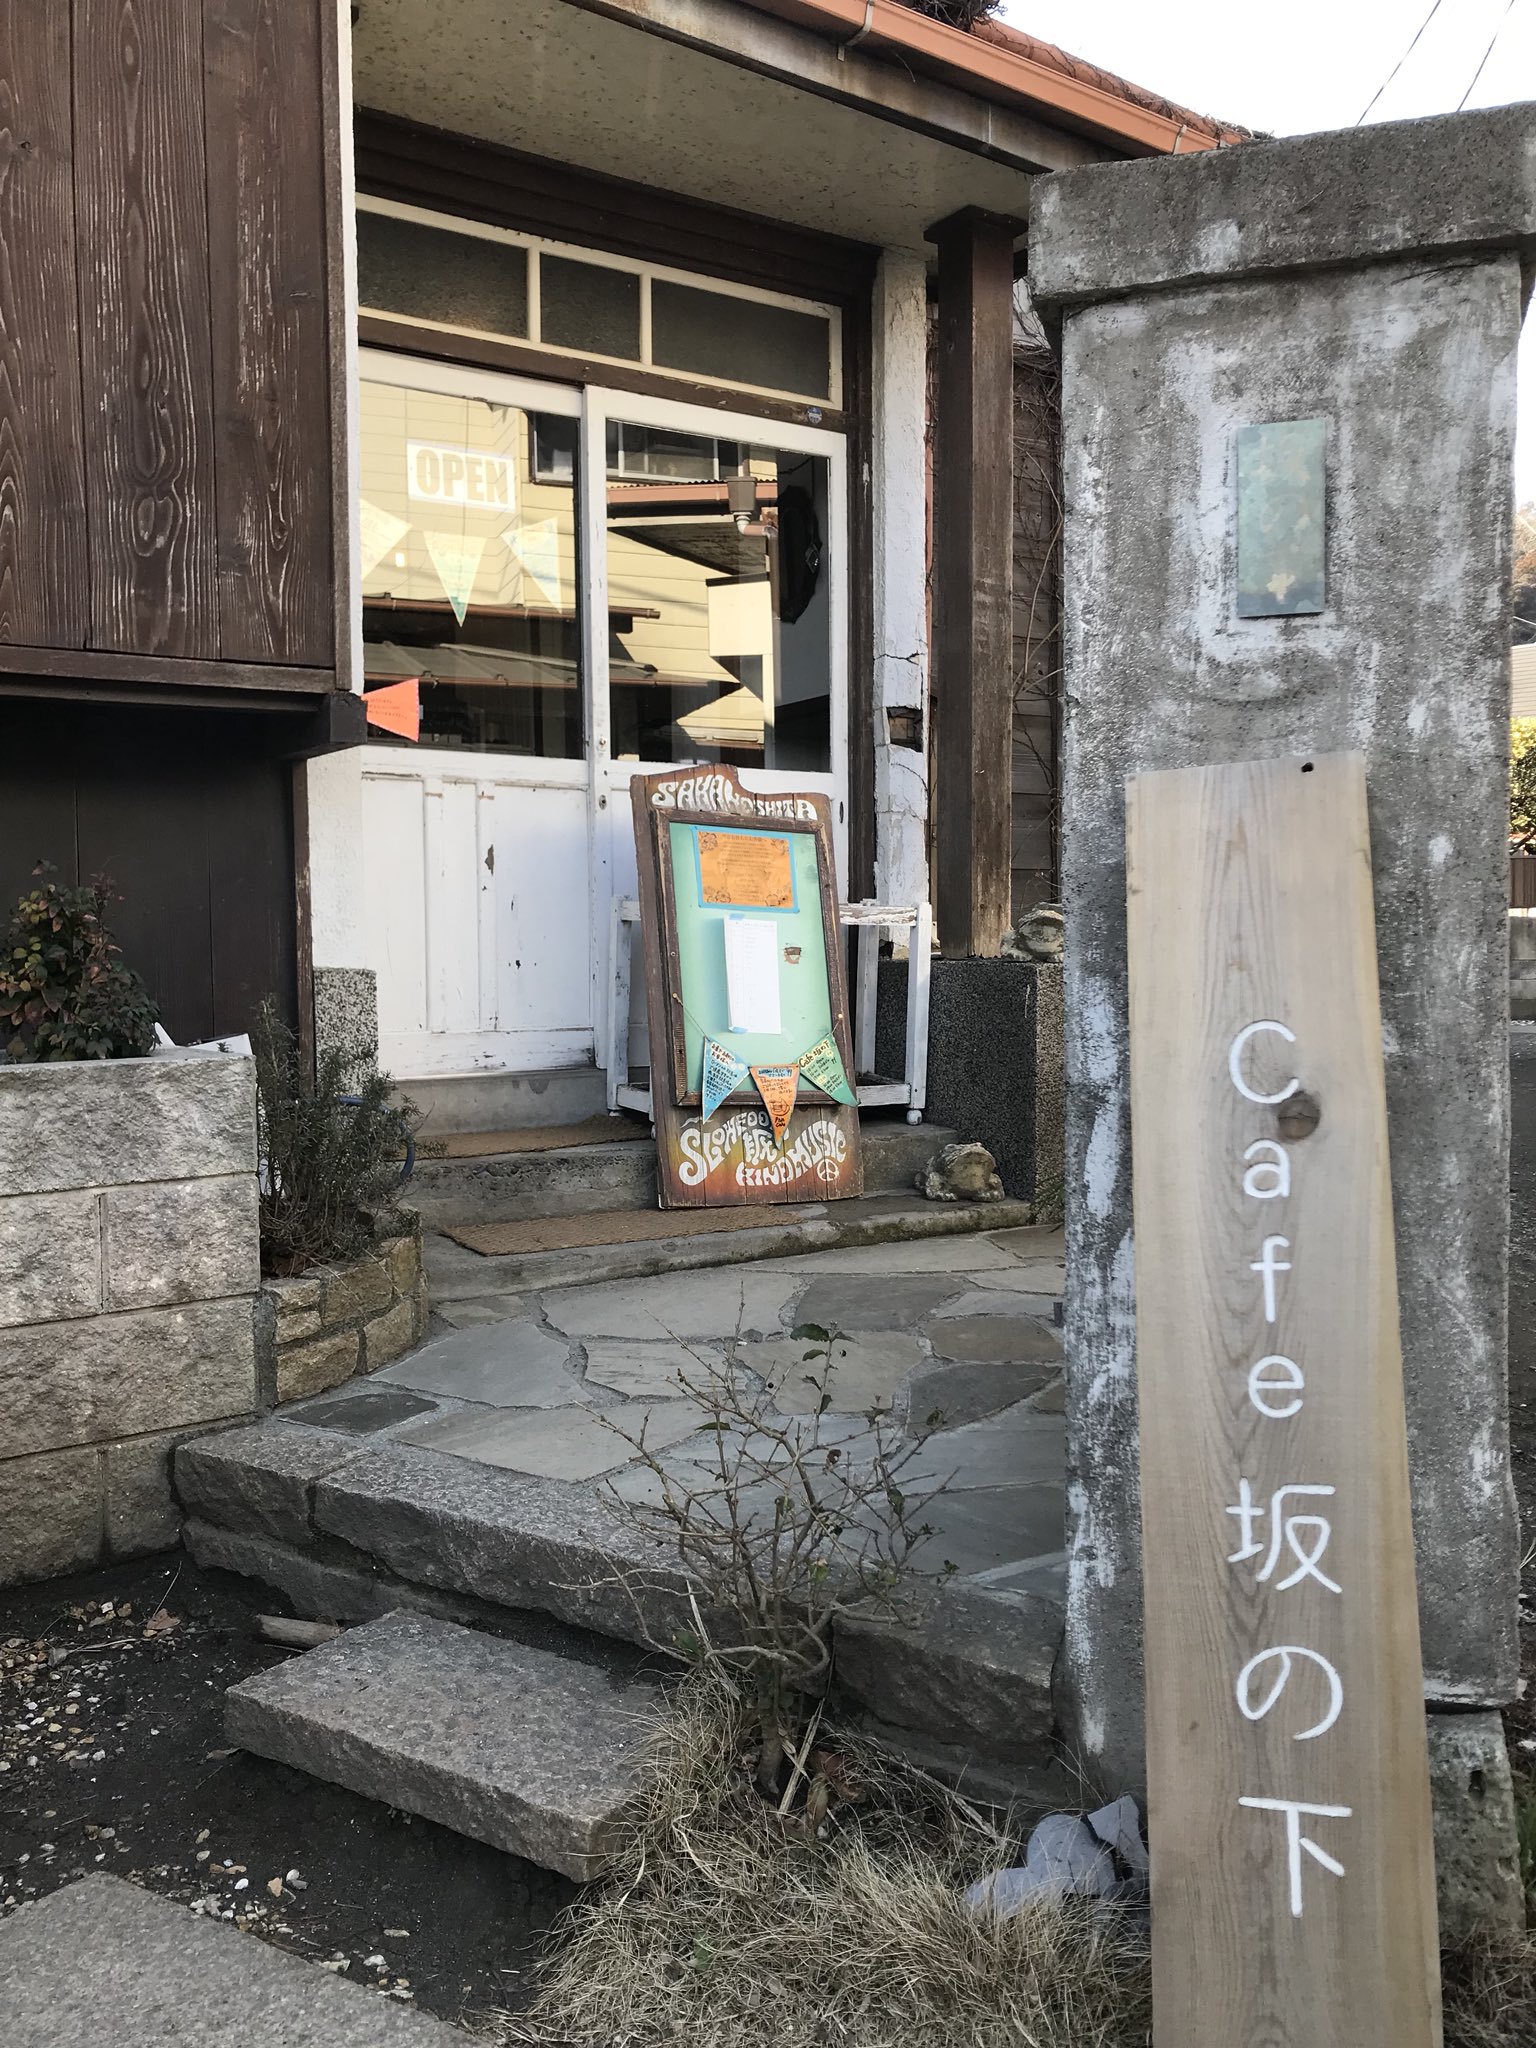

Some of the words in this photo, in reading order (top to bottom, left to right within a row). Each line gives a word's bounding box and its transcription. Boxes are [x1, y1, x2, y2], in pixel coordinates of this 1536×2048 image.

[416, 448, 509, 504] OPEN
[799, 1053, 813, 1068] Cafe
[1228, 1019, 1306, 1419] Cafe
[1226, 1476, 1353, 1919] 坂の下
